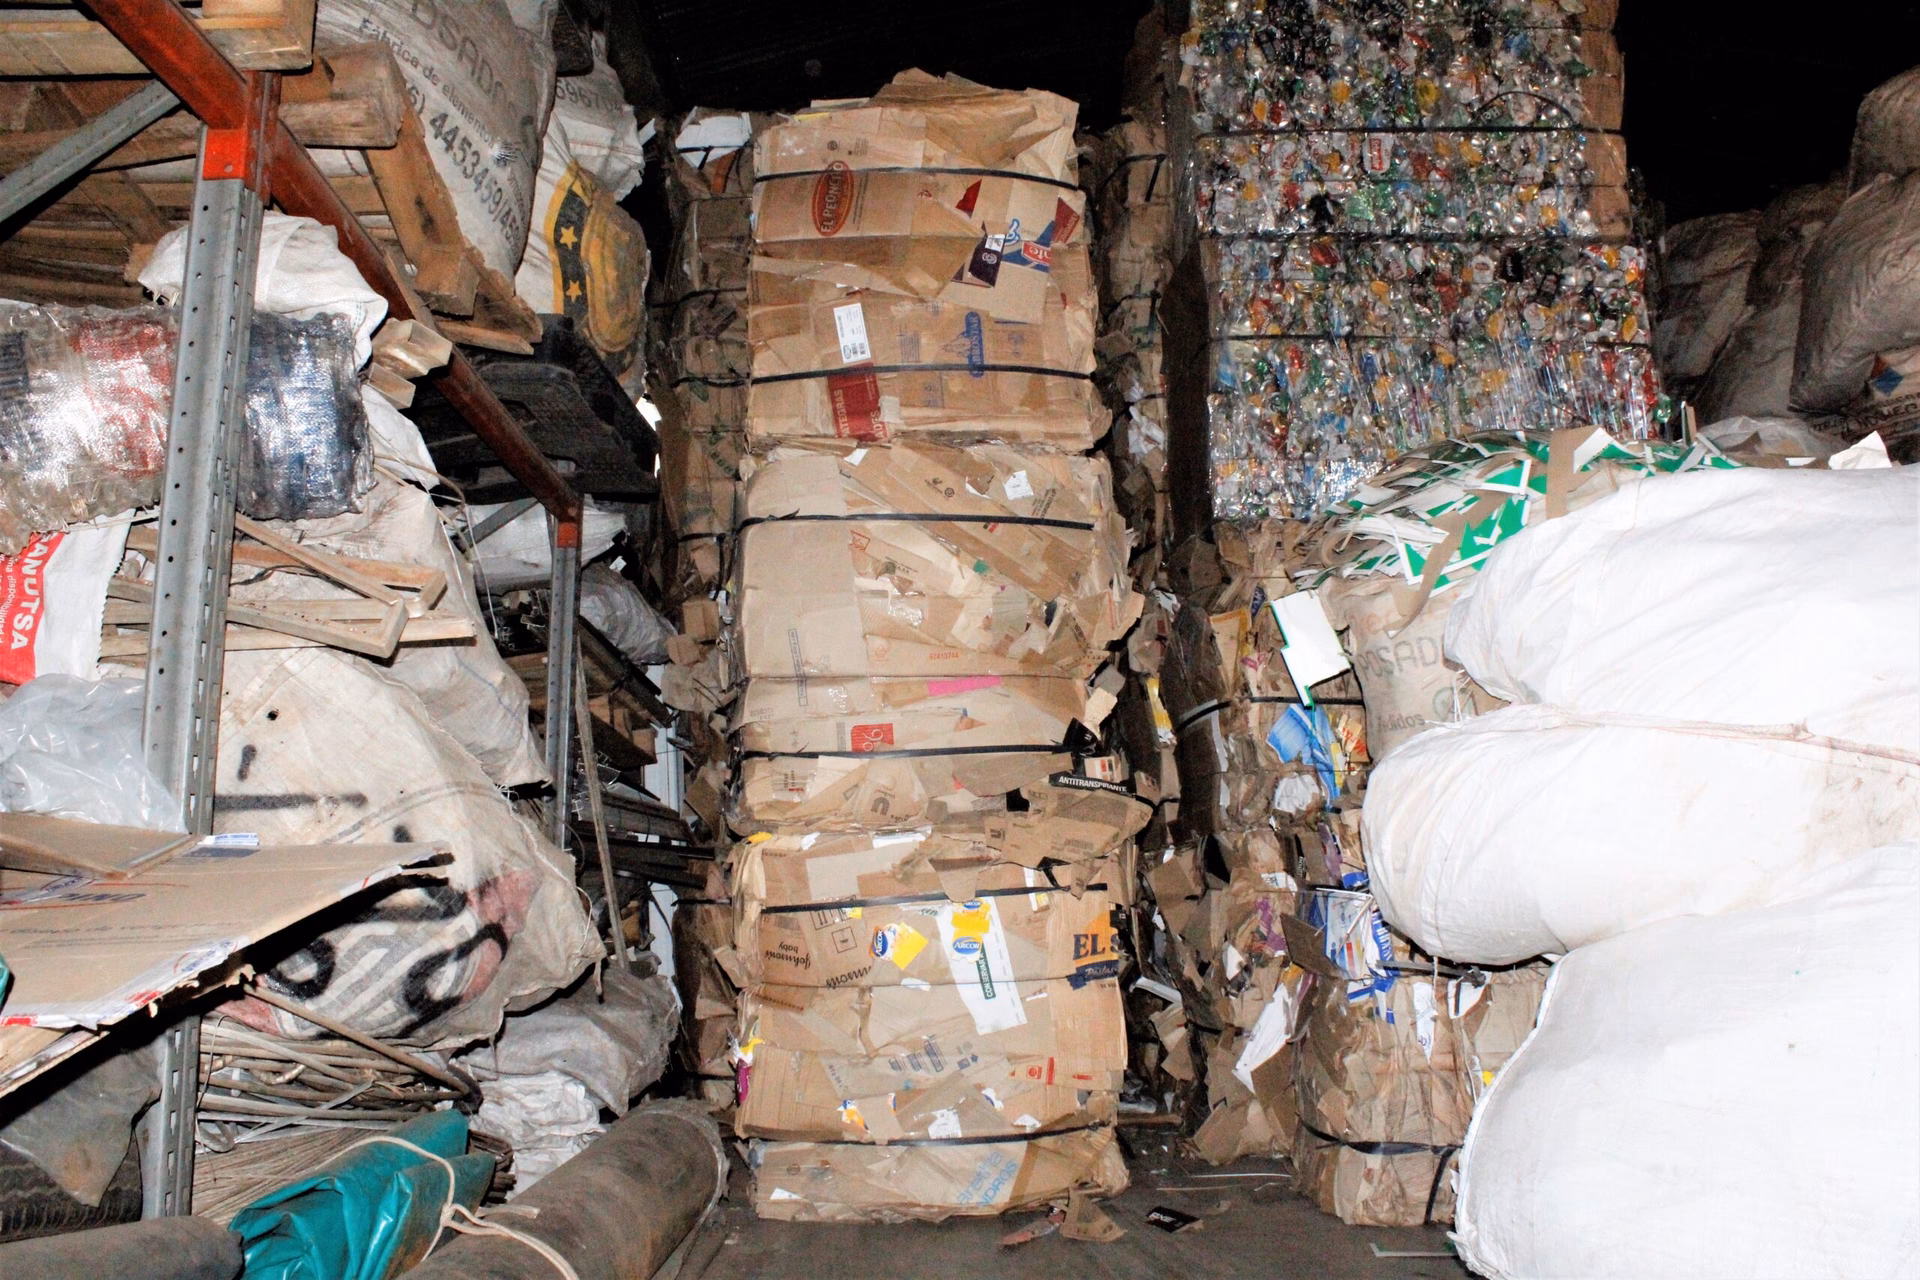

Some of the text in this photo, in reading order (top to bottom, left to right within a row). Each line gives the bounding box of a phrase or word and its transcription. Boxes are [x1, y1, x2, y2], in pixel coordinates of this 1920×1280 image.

[422, 66, 440, 86] de
[820, 219, 834, 233] EL
[969, 315, 981, 376] BROSTAR
[1058, 776, 1127, 792] ANTITRANSPIRANTE
[779, 941, 798, 954] baby
[875, 930, 883, 956] ARCOR
[953, 940, 980, 950] ARCOR
[1073, 933, 1106, 960] EL
[766, 949, 810, 970] Johnson's
